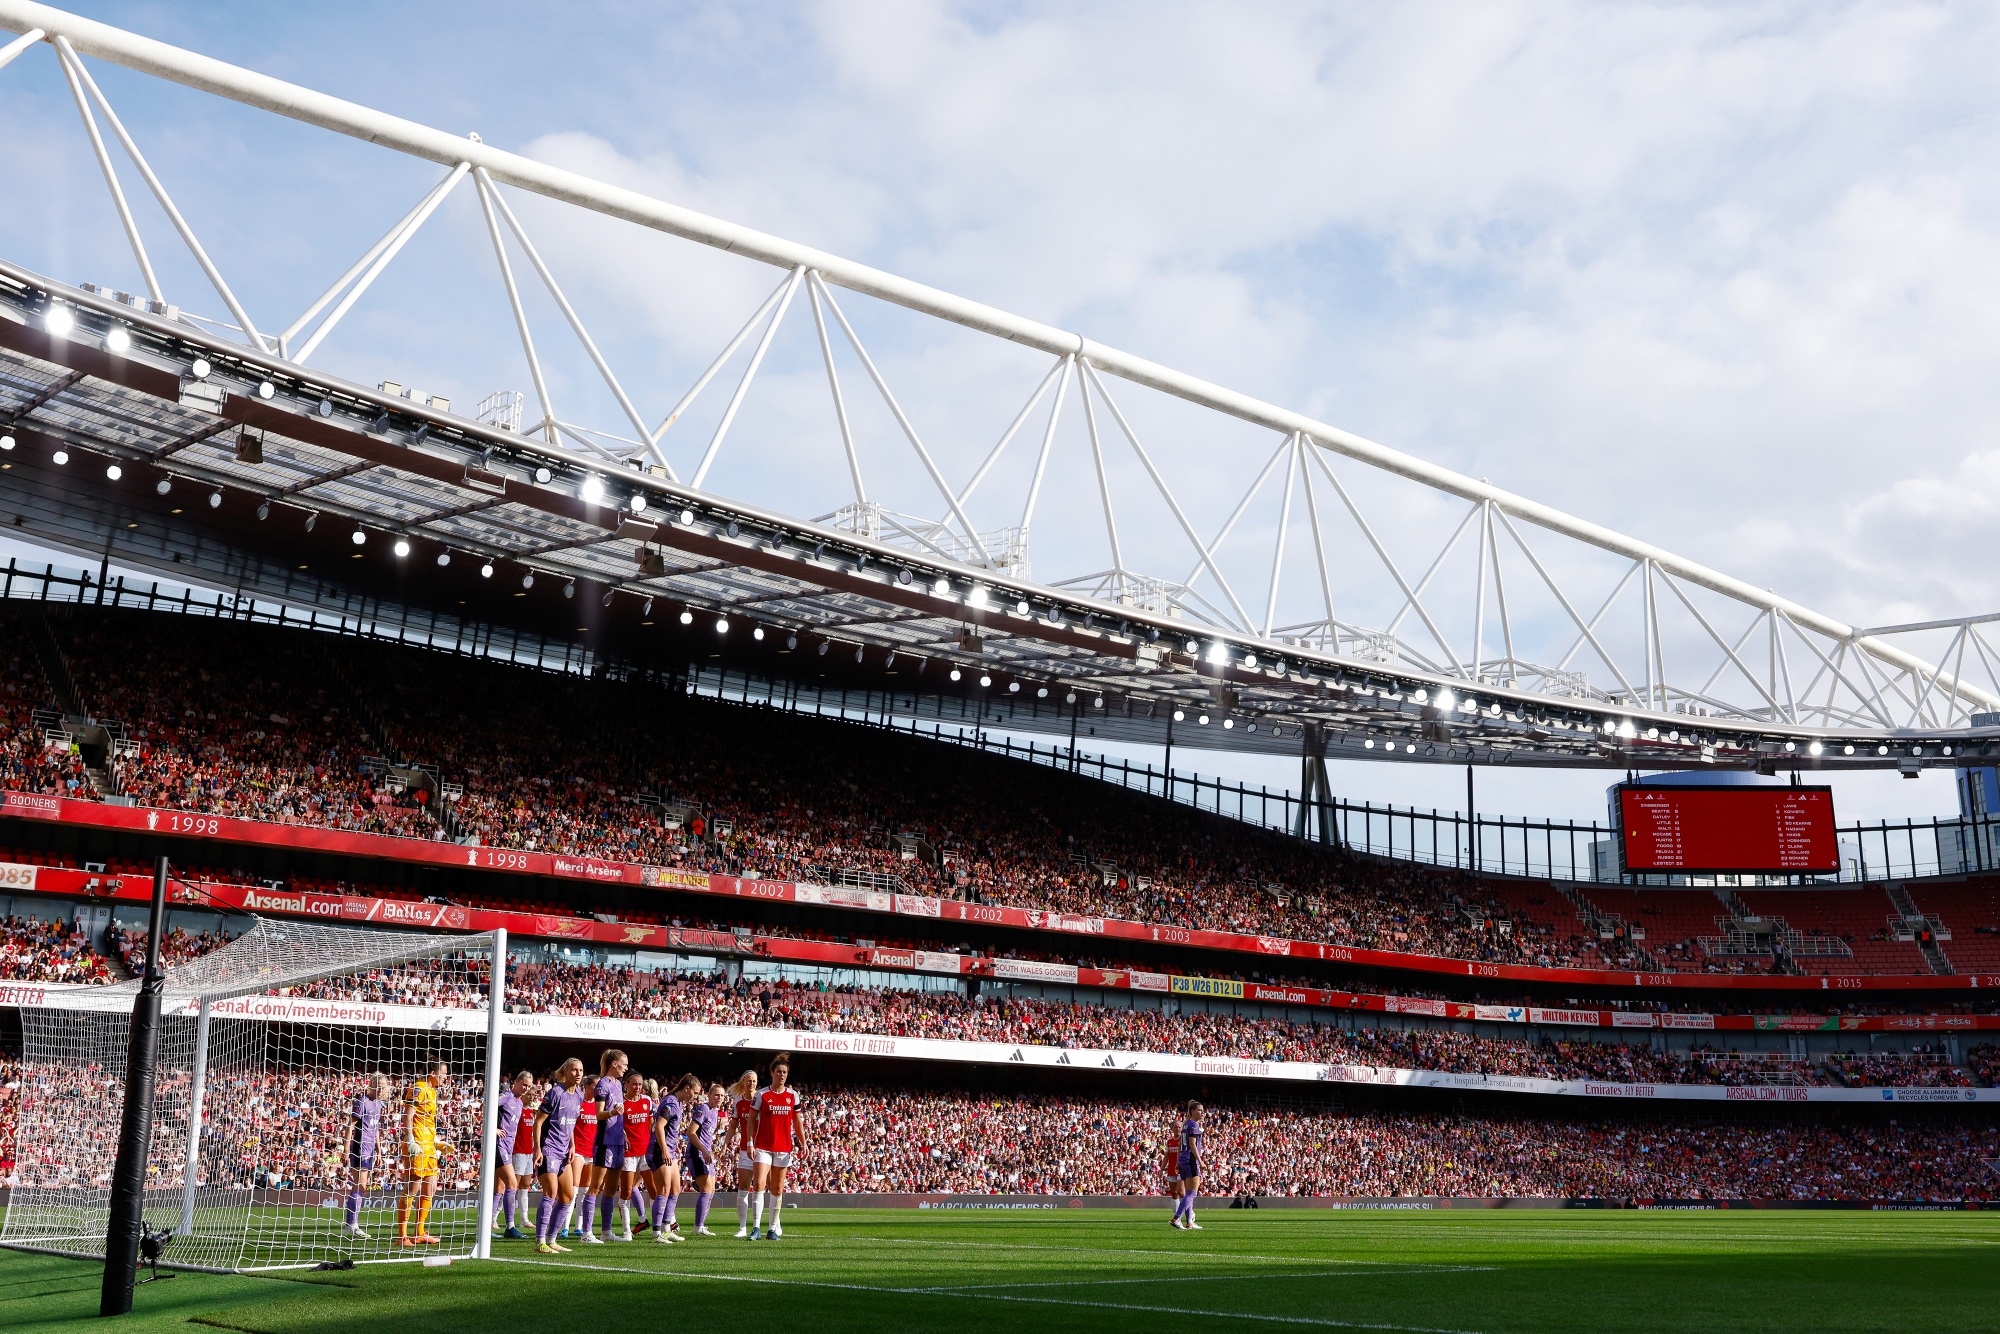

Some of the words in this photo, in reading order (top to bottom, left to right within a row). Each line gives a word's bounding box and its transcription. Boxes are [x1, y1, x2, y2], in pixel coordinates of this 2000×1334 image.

[10, 795, 57, 809] GOONERS
[171, 815, 218, 834] 1998
[487, 852, 527, 869] 1998
[555, 860, 583, 873] Merci
[586, 863, 622, 877] Arsène
[660, 872, 681, 884] MIKEL
[682, 875, 709, 887] ARTETA
[751, 882, 784, 897] 2002
[242, 891, 342, 916] Arsenal.com
[383, 901, 431, 920] Dallas
[973, 908, 1002, 921] 2002
[1165, 930, 1190, 942] 2003
[872, 950, 914, 967] Arsenal
[1330, 948, 1352, 960] 2004
[995, 963, 1019, 972] SOUTH
[1020, 966, 1043, 975] WALES
[1045, 968, 1077, 978] GOONERS
[1478, 966, 1499, 976] 2005
[1173, 977, 1189, 991] P38
[1192, 979, 1211, 993] W26
[1213, 981, 1230, 995] D12
[1649, 975, 1672, 985] 2014
[1837, 979, 1862, 988] 2015
[0, 986, 45, 1005] BETTER
[1255, 986, 1306, 1003] Arsenal.com
[188, 997, 386, 1024] Asenal.com/membership
[1541, 1010, 1569, 1022] MILTON
[1570, 1011, 1598, 1024] KEYNES
[508, 1017, 541, 1027] SOBHA
[574, 1021, 606, 1031] SOBHA
[637, 1025, 668, 1035] SOBHA
[794, 1034, 849, 1051] Emirates
[853, 1038, 867, 1052] FLY
[868, 1039, 896, 1054] BETTER
[1194, 1060, 1235, 1073] Emirates
[1237, 1063, 1248, 1075] FLY
[1249, 1064, 1270, 1076] BETTER
[1328, 1066, 1397, 1084] ARSENAL.COM/TOURS
[1454, 1075, 1526, 1089] hospitality.arsenal.com
[1585, 1083, 1622, 1096] Emirates
[1625, 1085, 1635, 1096] FLY
[1636, 1085, 1655, 1097] BETTER
[1726, 1087, 1808, 1101] ARSENAL.COM/TOURS
